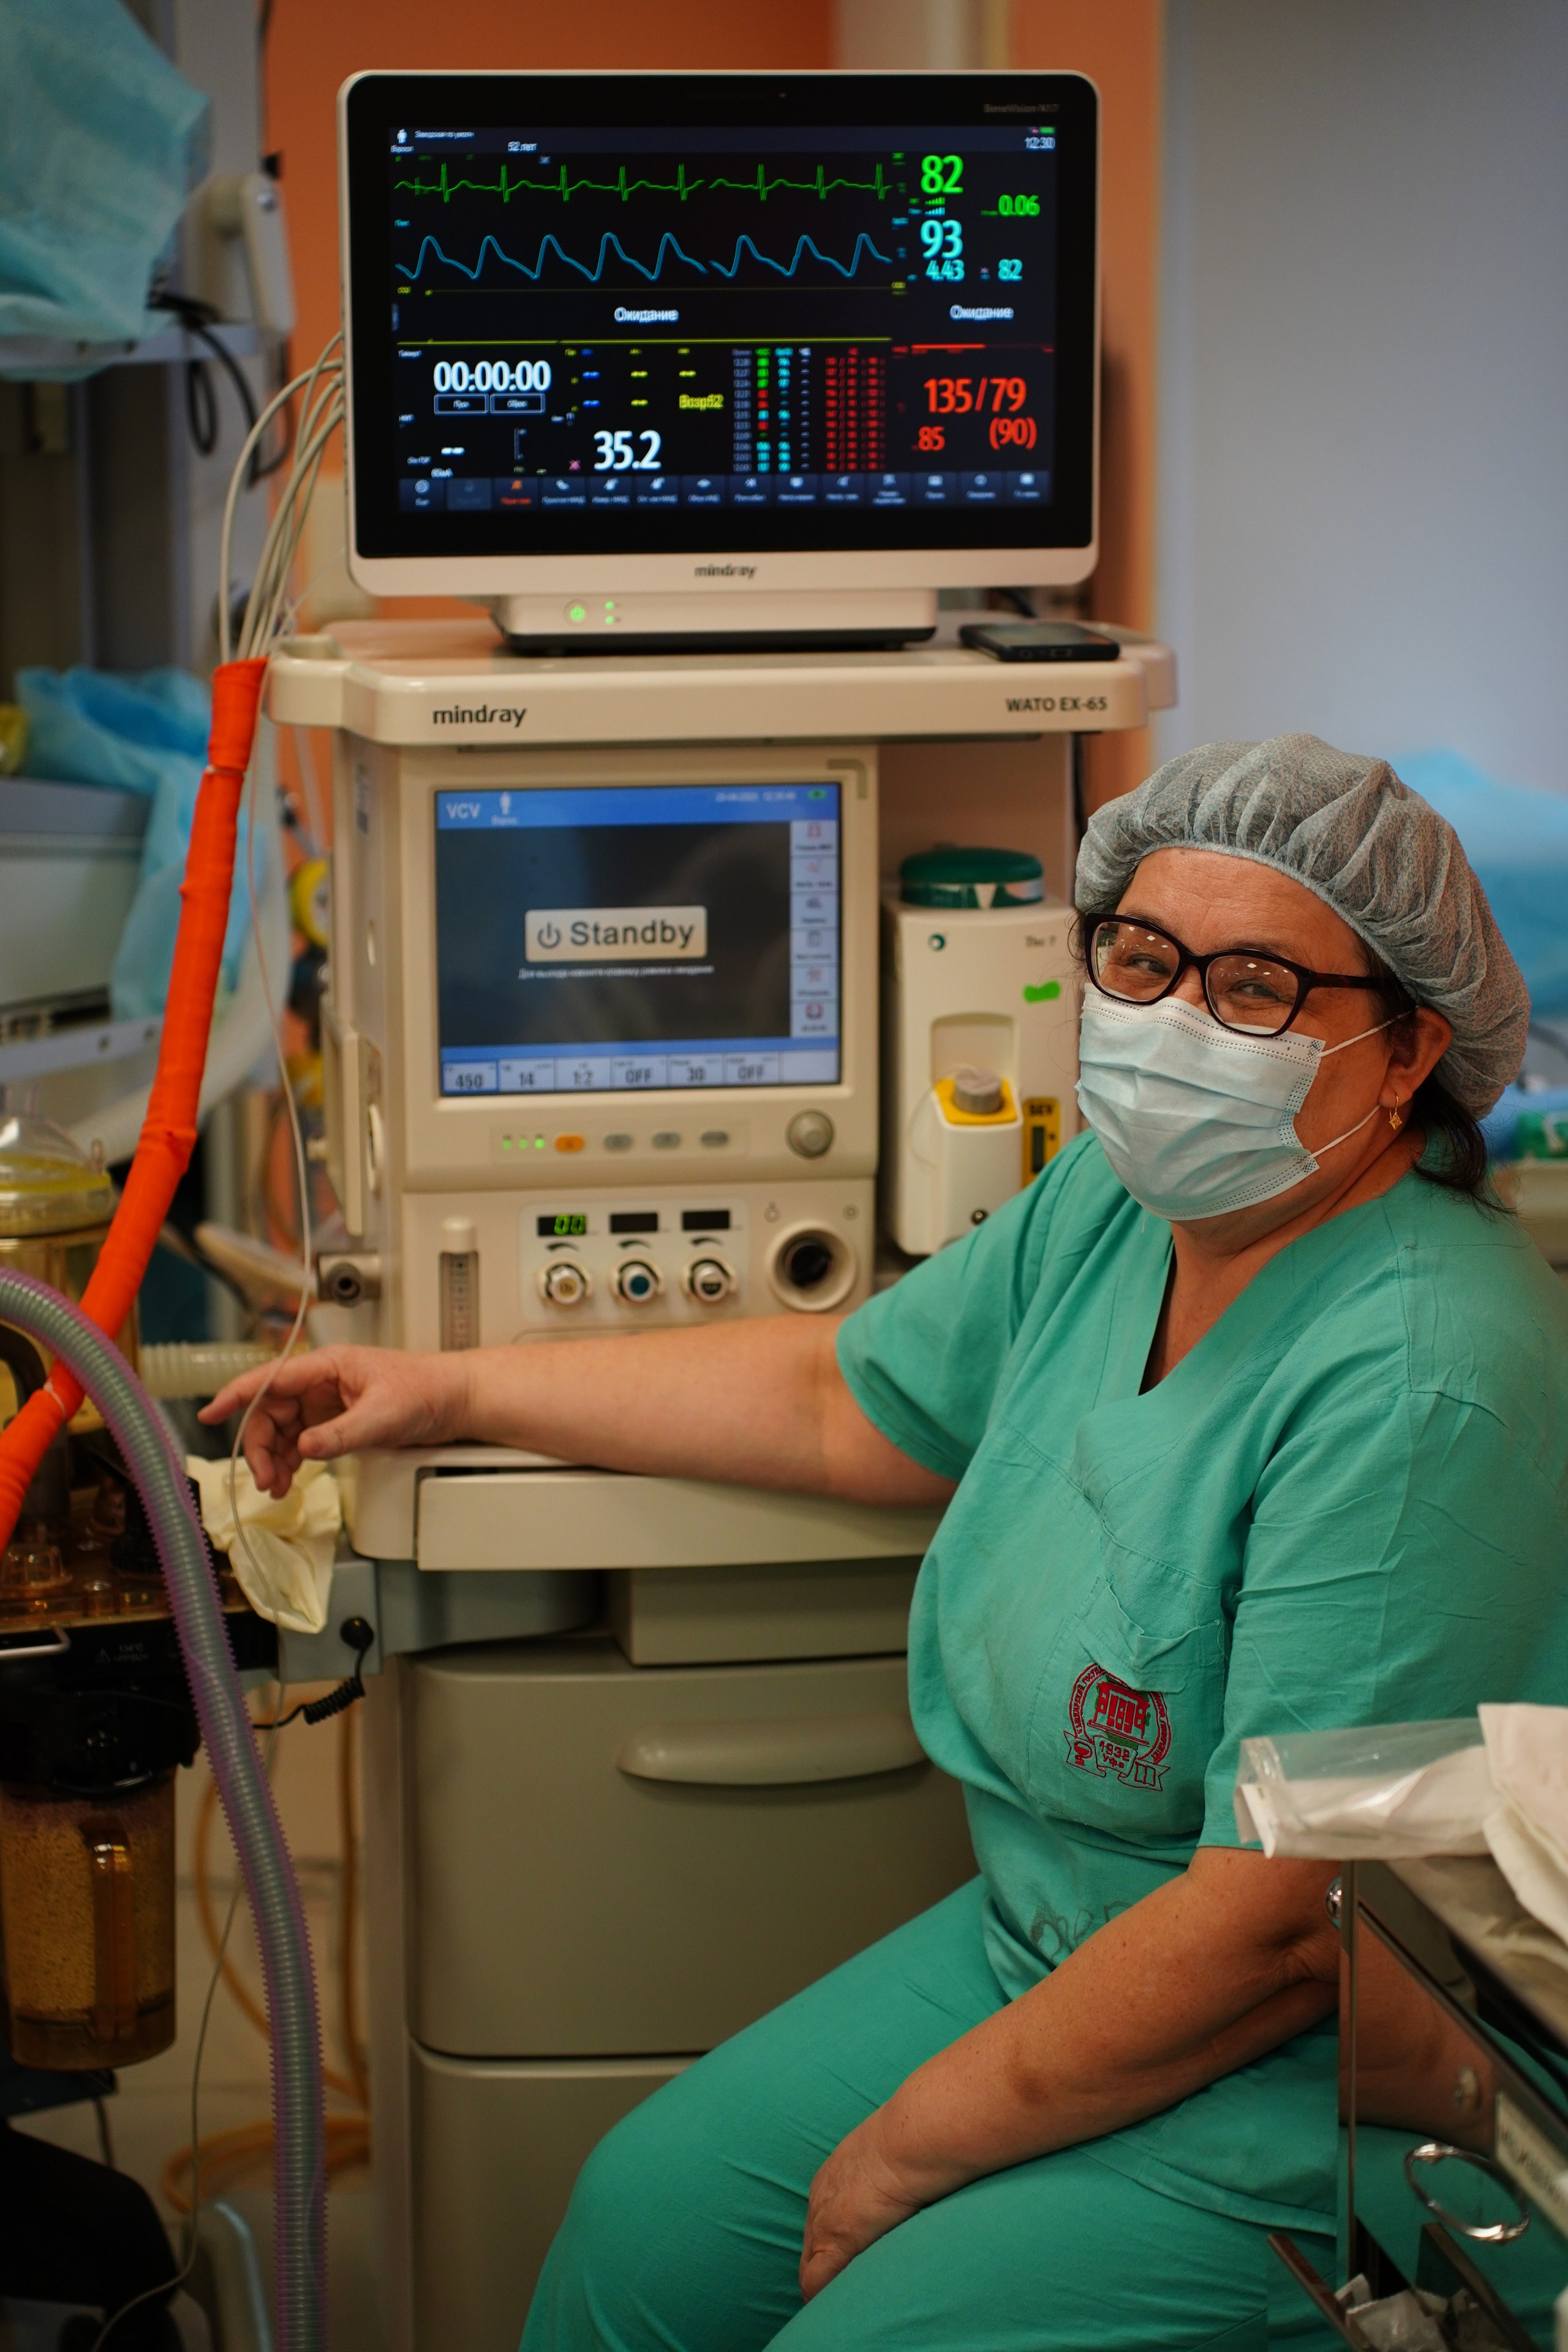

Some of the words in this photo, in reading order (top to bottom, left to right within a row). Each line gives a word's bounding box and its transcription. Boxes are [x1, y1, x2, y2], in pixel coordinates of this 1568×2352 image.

[921, 156, 963, 194] 82
[998, 195, 1039, 216] 0.06
[921, 220, 963, 258] 93
[925, 259, 964, 281] 4.43
[998, 259, 1022, 281] 82
[614, 307, 679, 323] Ожидание
[950, 305, 1014, 321] Ожидание
[434, 360, 551, 392] 00:00:00
[924, 377, 1026, 413] 135/79
[919, 426, 944, 450] 85
[990, 417, 1036, 449] (90)
[594, 431, 661, 470] 35.2
[695, 565, 755, 579] mindray
[1006, 698, 1055, 712] WATO
[1060, 697, 1107, 711] EX-65
[434, 705, 526, 728] mindray
[447, 803, 481, 818] VCV
[571, 921, 693, 949] Standby
[455, 1074, 484, 1088] 450
[521, 1073, 534, 1086] 14
[1099, 1741, 1129, 1762] 1932
